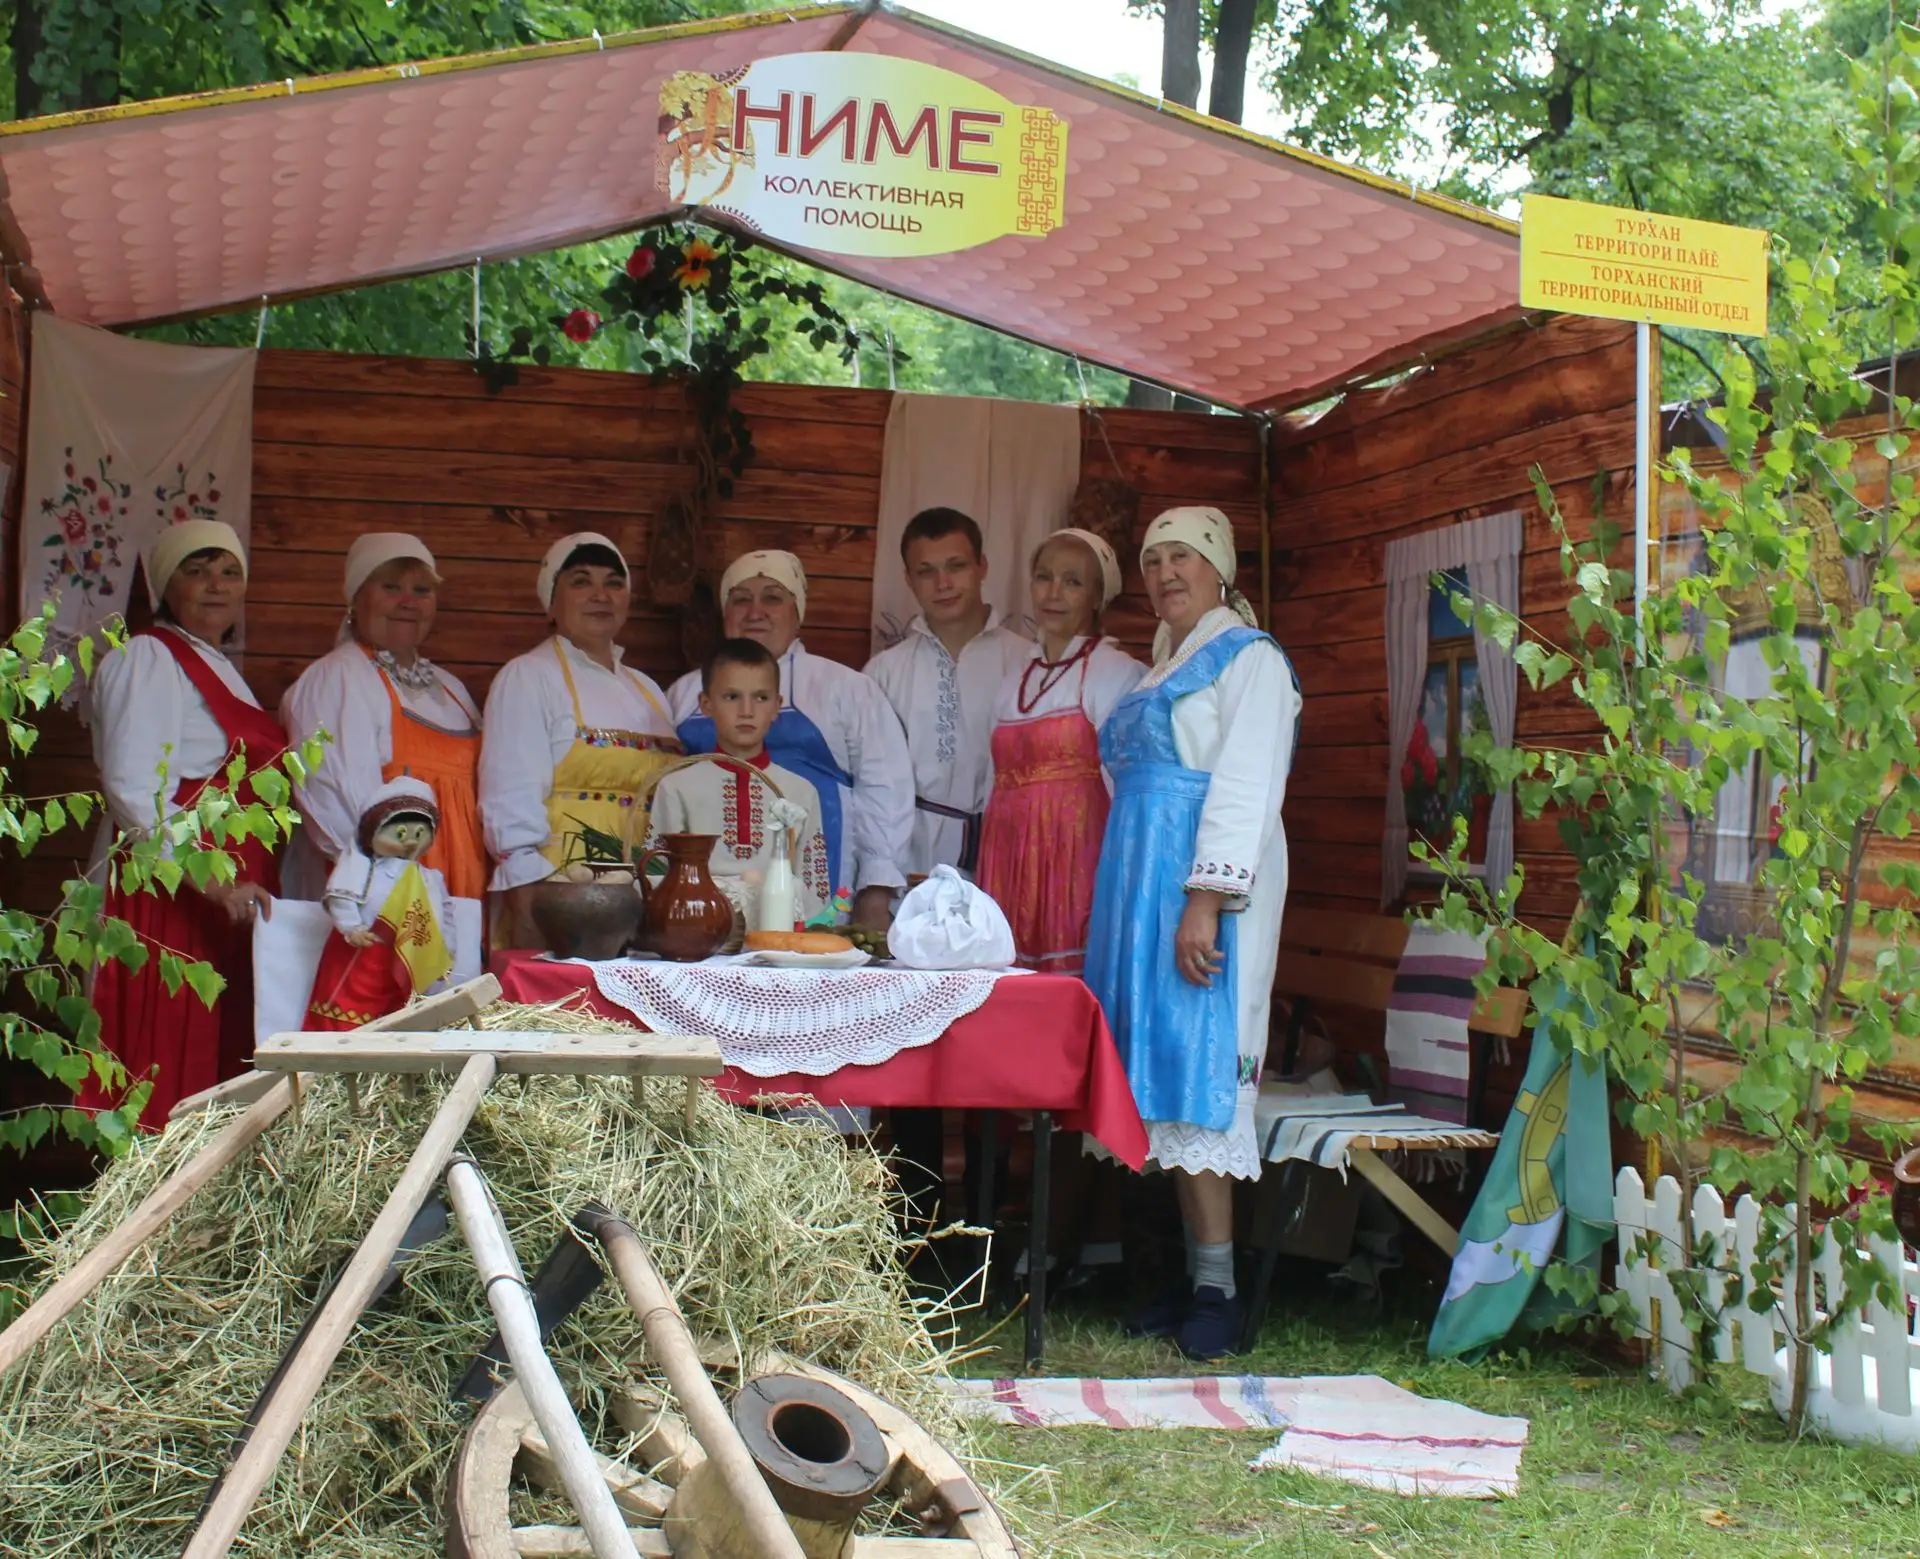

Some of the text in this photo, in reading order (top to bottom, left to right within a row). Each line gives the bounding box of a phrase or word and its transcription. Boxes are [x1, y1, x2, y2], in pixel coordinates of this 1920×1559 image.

[732, 87, 1002, 177] НИМЕ
[765, 174, 963, 209] КОЛЛЕКТИВНАЯ
[804, 206, 922, 233] ПОМОЩЬ
[1616, 218, 1681, 242] ТУРХАН
[1575, 233, 1672, 262] ТЕРРИТОРИ
[1591, 265, 1703, 294] ТОРХАНСКИЙ
[1540, 280, 1749, 322] ТЕРРИТОРИАЛЬНЫЙ ОТДЕЛ
